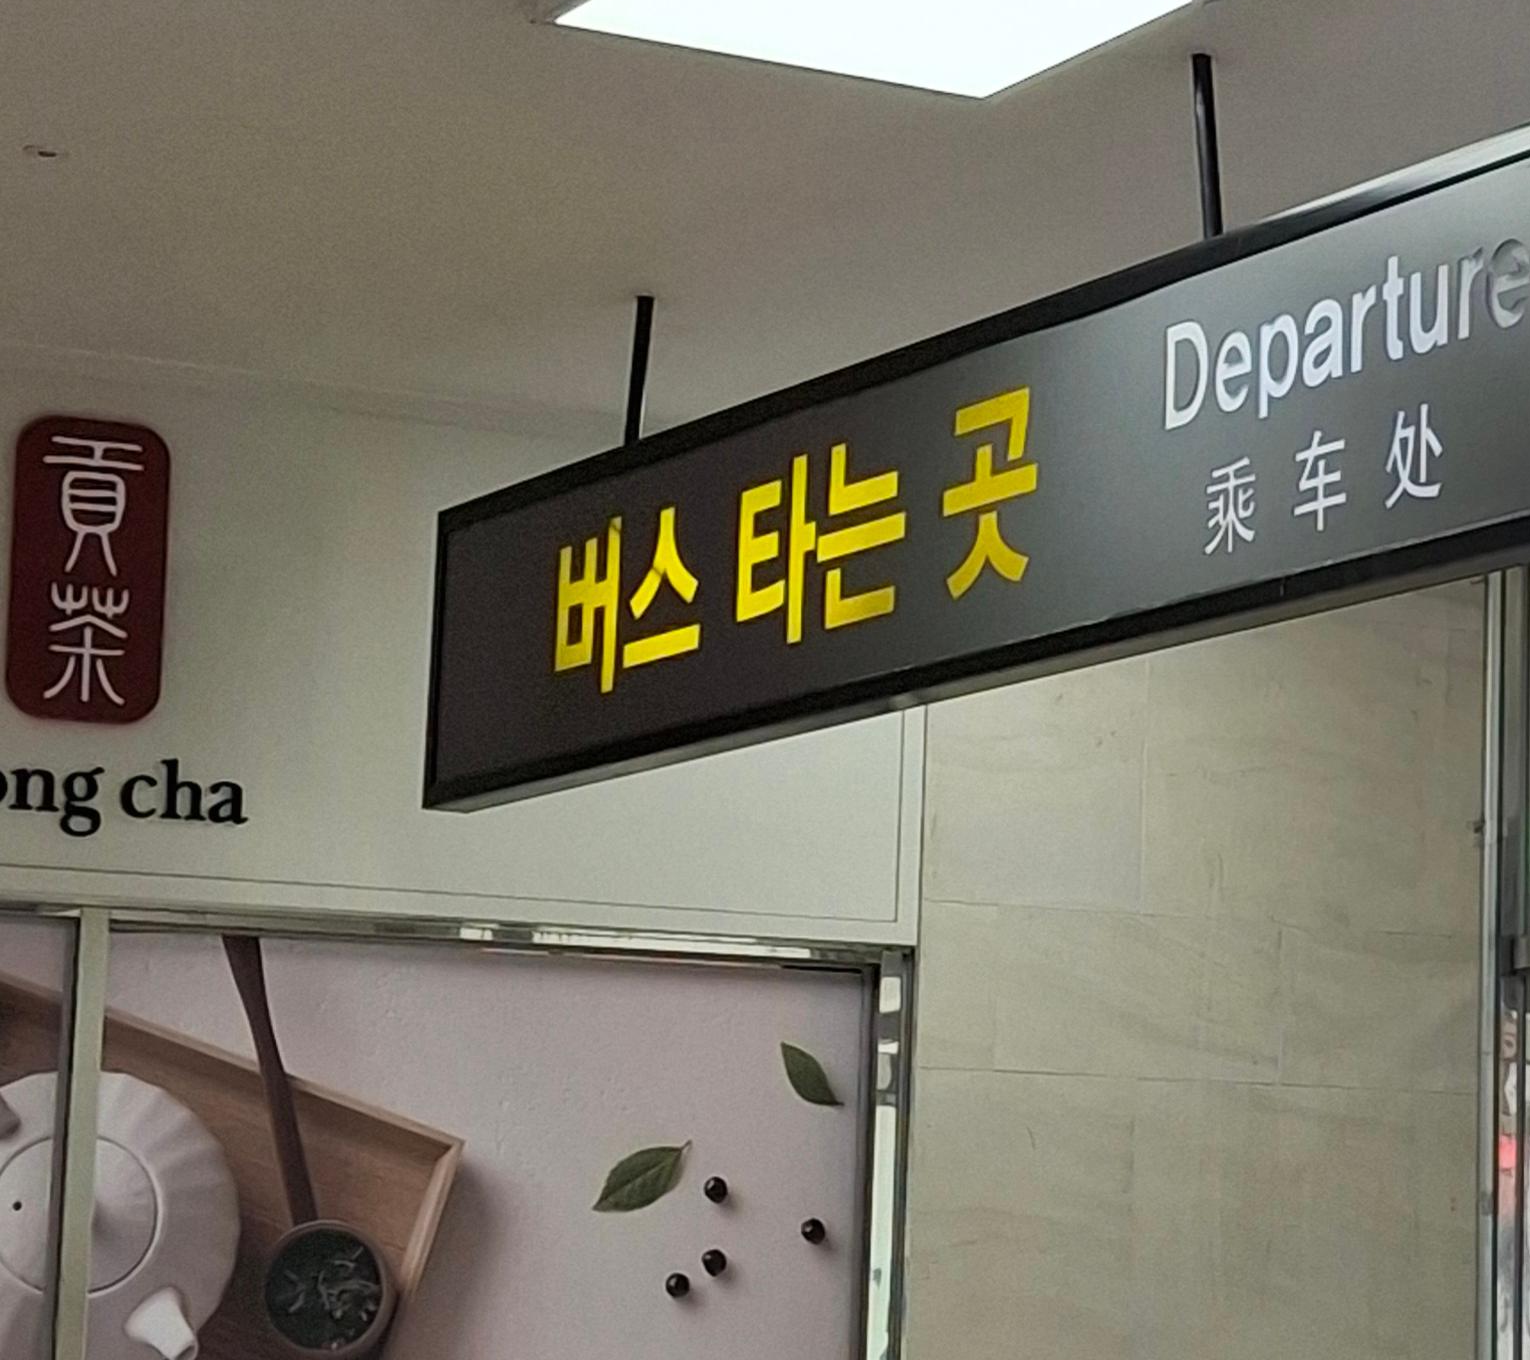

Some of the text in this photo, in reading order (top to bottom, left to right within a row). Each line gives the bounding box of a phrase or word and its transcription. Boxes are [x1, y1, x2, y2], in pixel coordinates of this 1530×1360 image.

[1164, 238, 1530, 430] Departure
[554, 386, 1038, 694] 버스 타는 곳
[1203, 403, 1443, 556] 乘车处
[0, 759, 248, 837] ng cha
